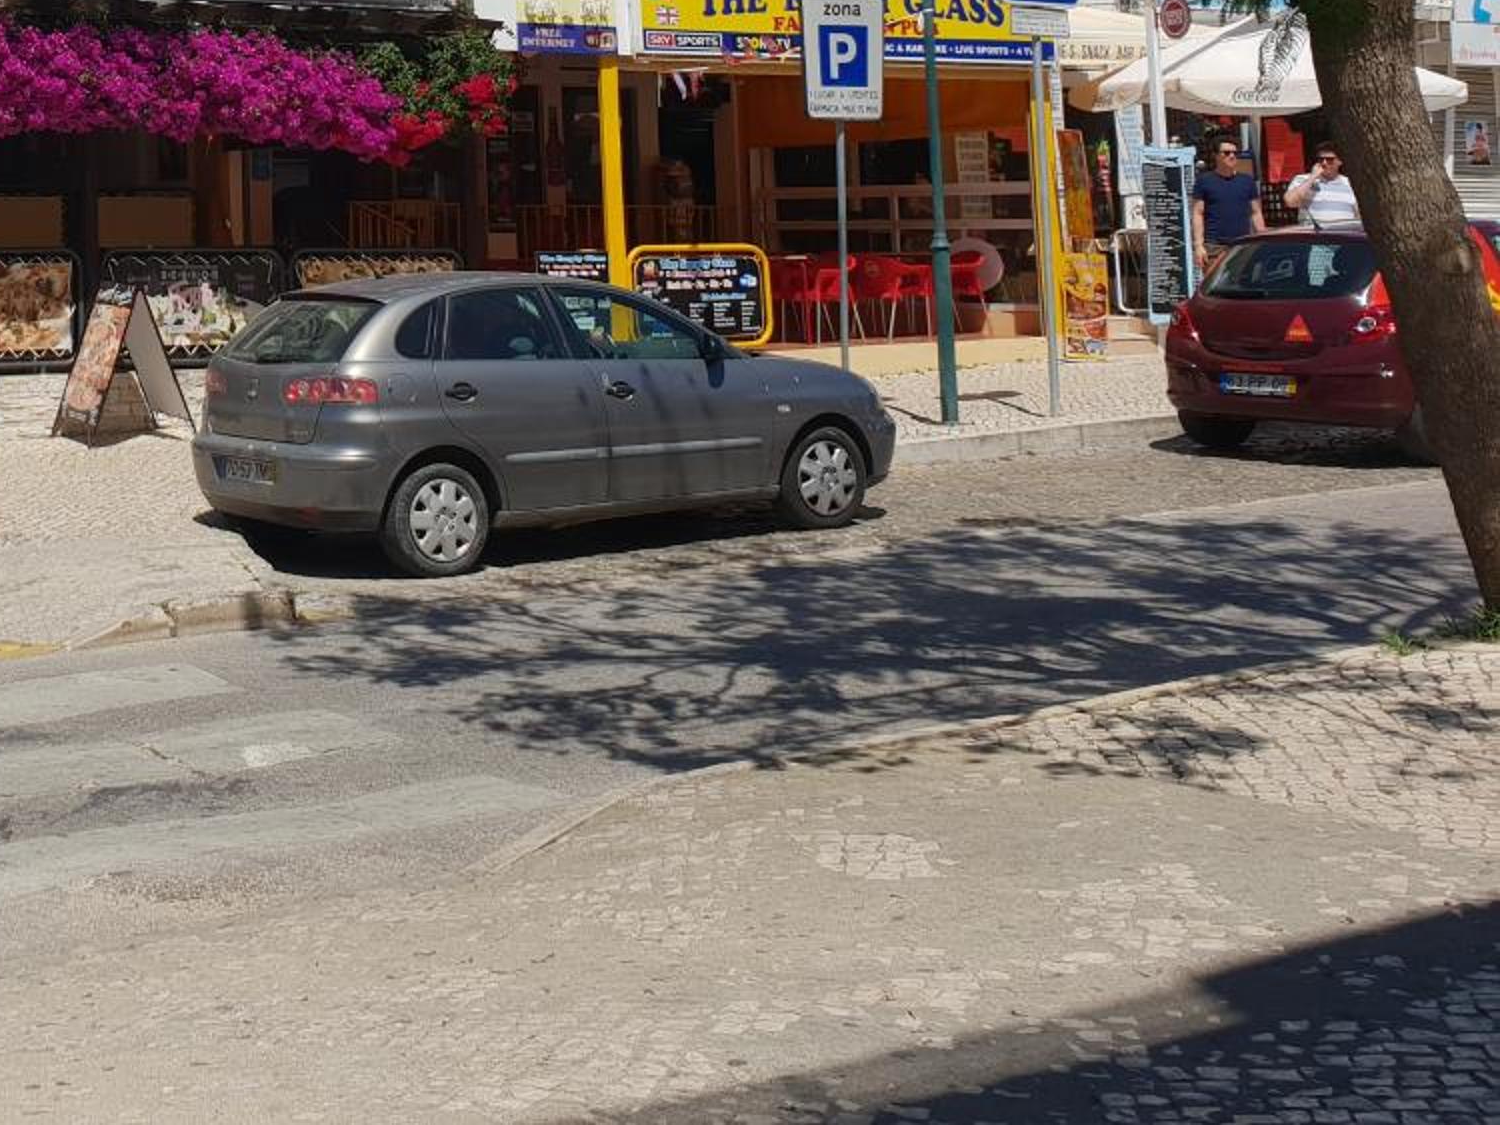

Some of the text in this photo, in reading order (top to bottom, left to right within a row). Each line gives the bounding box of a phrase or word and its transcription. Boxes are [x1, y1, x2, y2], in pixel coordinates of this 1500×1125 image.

[822, 3, 862, 17] zona
[521, 37, 576, 48] INTERNET
[650, 34, 719, 47] SKY SPORTS
[828, 32, 858, 80] P
[955, 45, 1009, 56] LIVE SPORTS
[1081, 44, 1110, 60] SNACK
